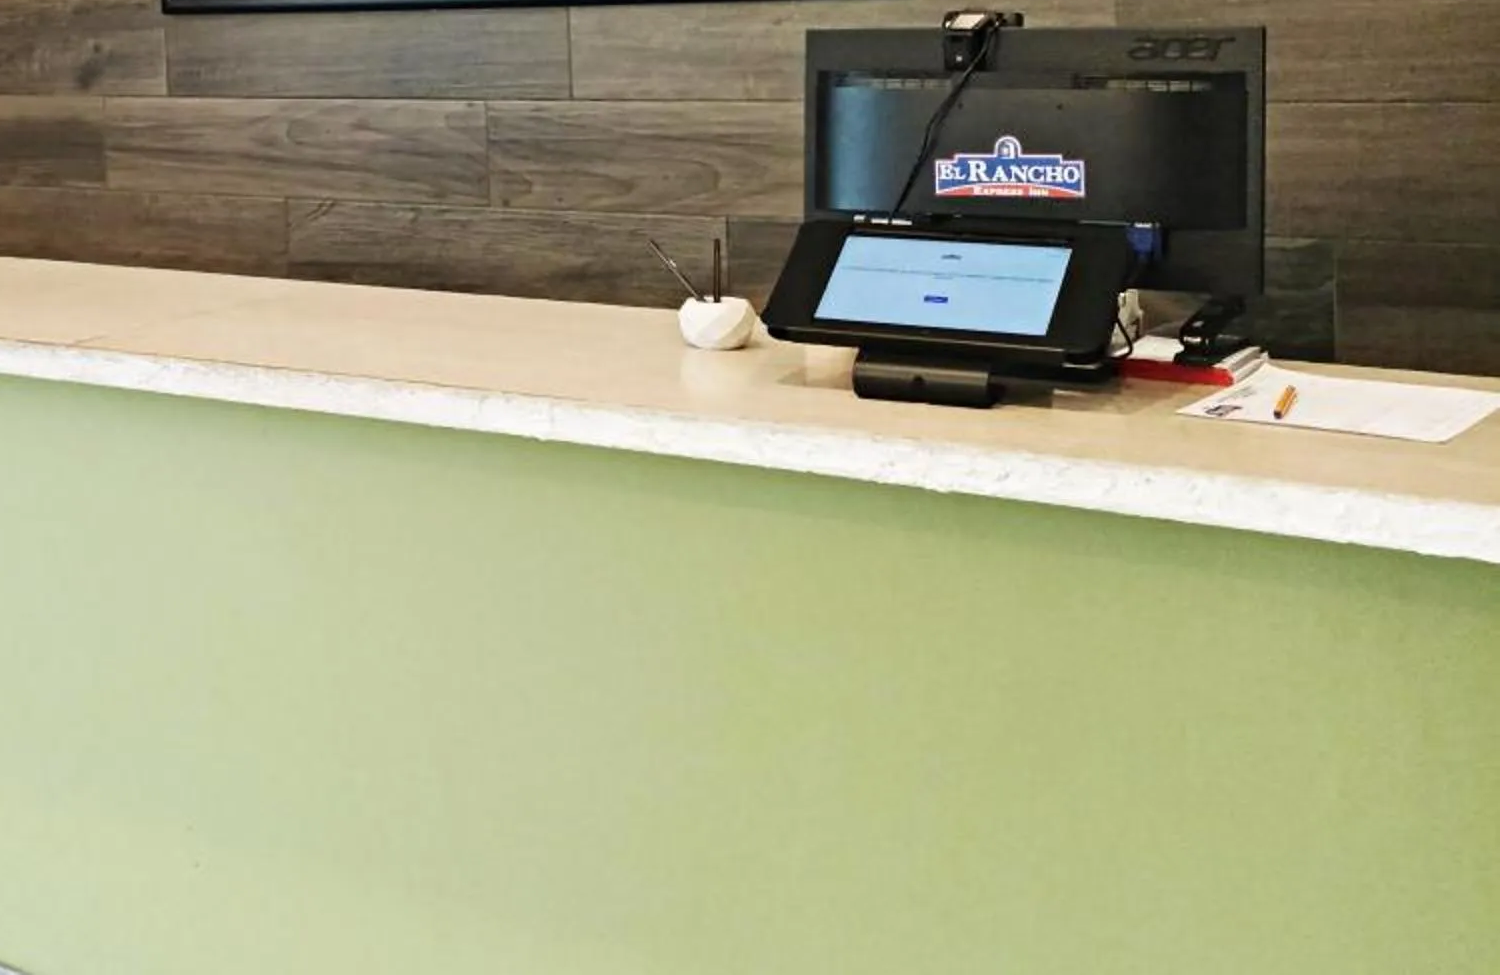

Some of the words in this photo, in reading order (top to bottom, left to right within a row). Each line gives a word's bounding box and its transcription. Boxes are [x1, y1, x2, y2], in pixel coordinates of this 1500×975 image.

[1127, 36, 1236, 62] acer
[939, 164, 966, 180] EL
[967, 160, 1081, 183] RANCHO
